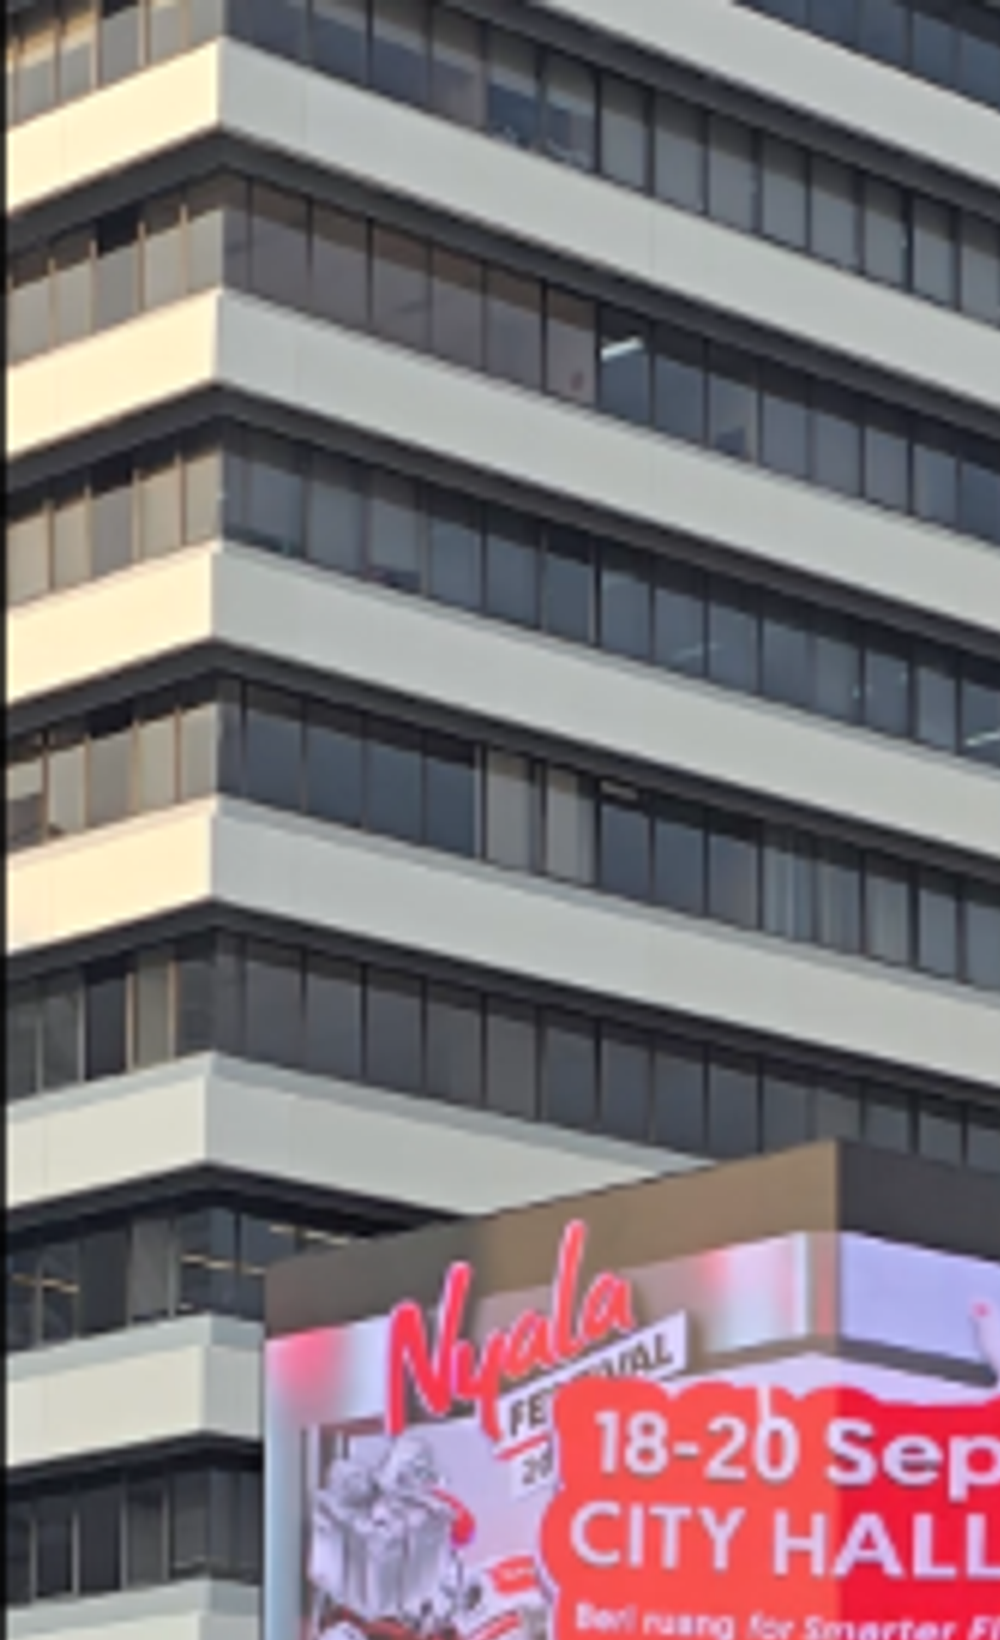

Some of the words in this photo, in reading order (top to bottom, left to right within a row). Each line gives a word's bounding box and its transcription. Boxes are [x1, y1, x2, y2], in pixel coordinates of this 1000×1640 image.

[385, 1219, 635, 1442] Nyala
[593, 1410, 800, 1485] 18-20
[568, 1500, 746, 1572] CITY
